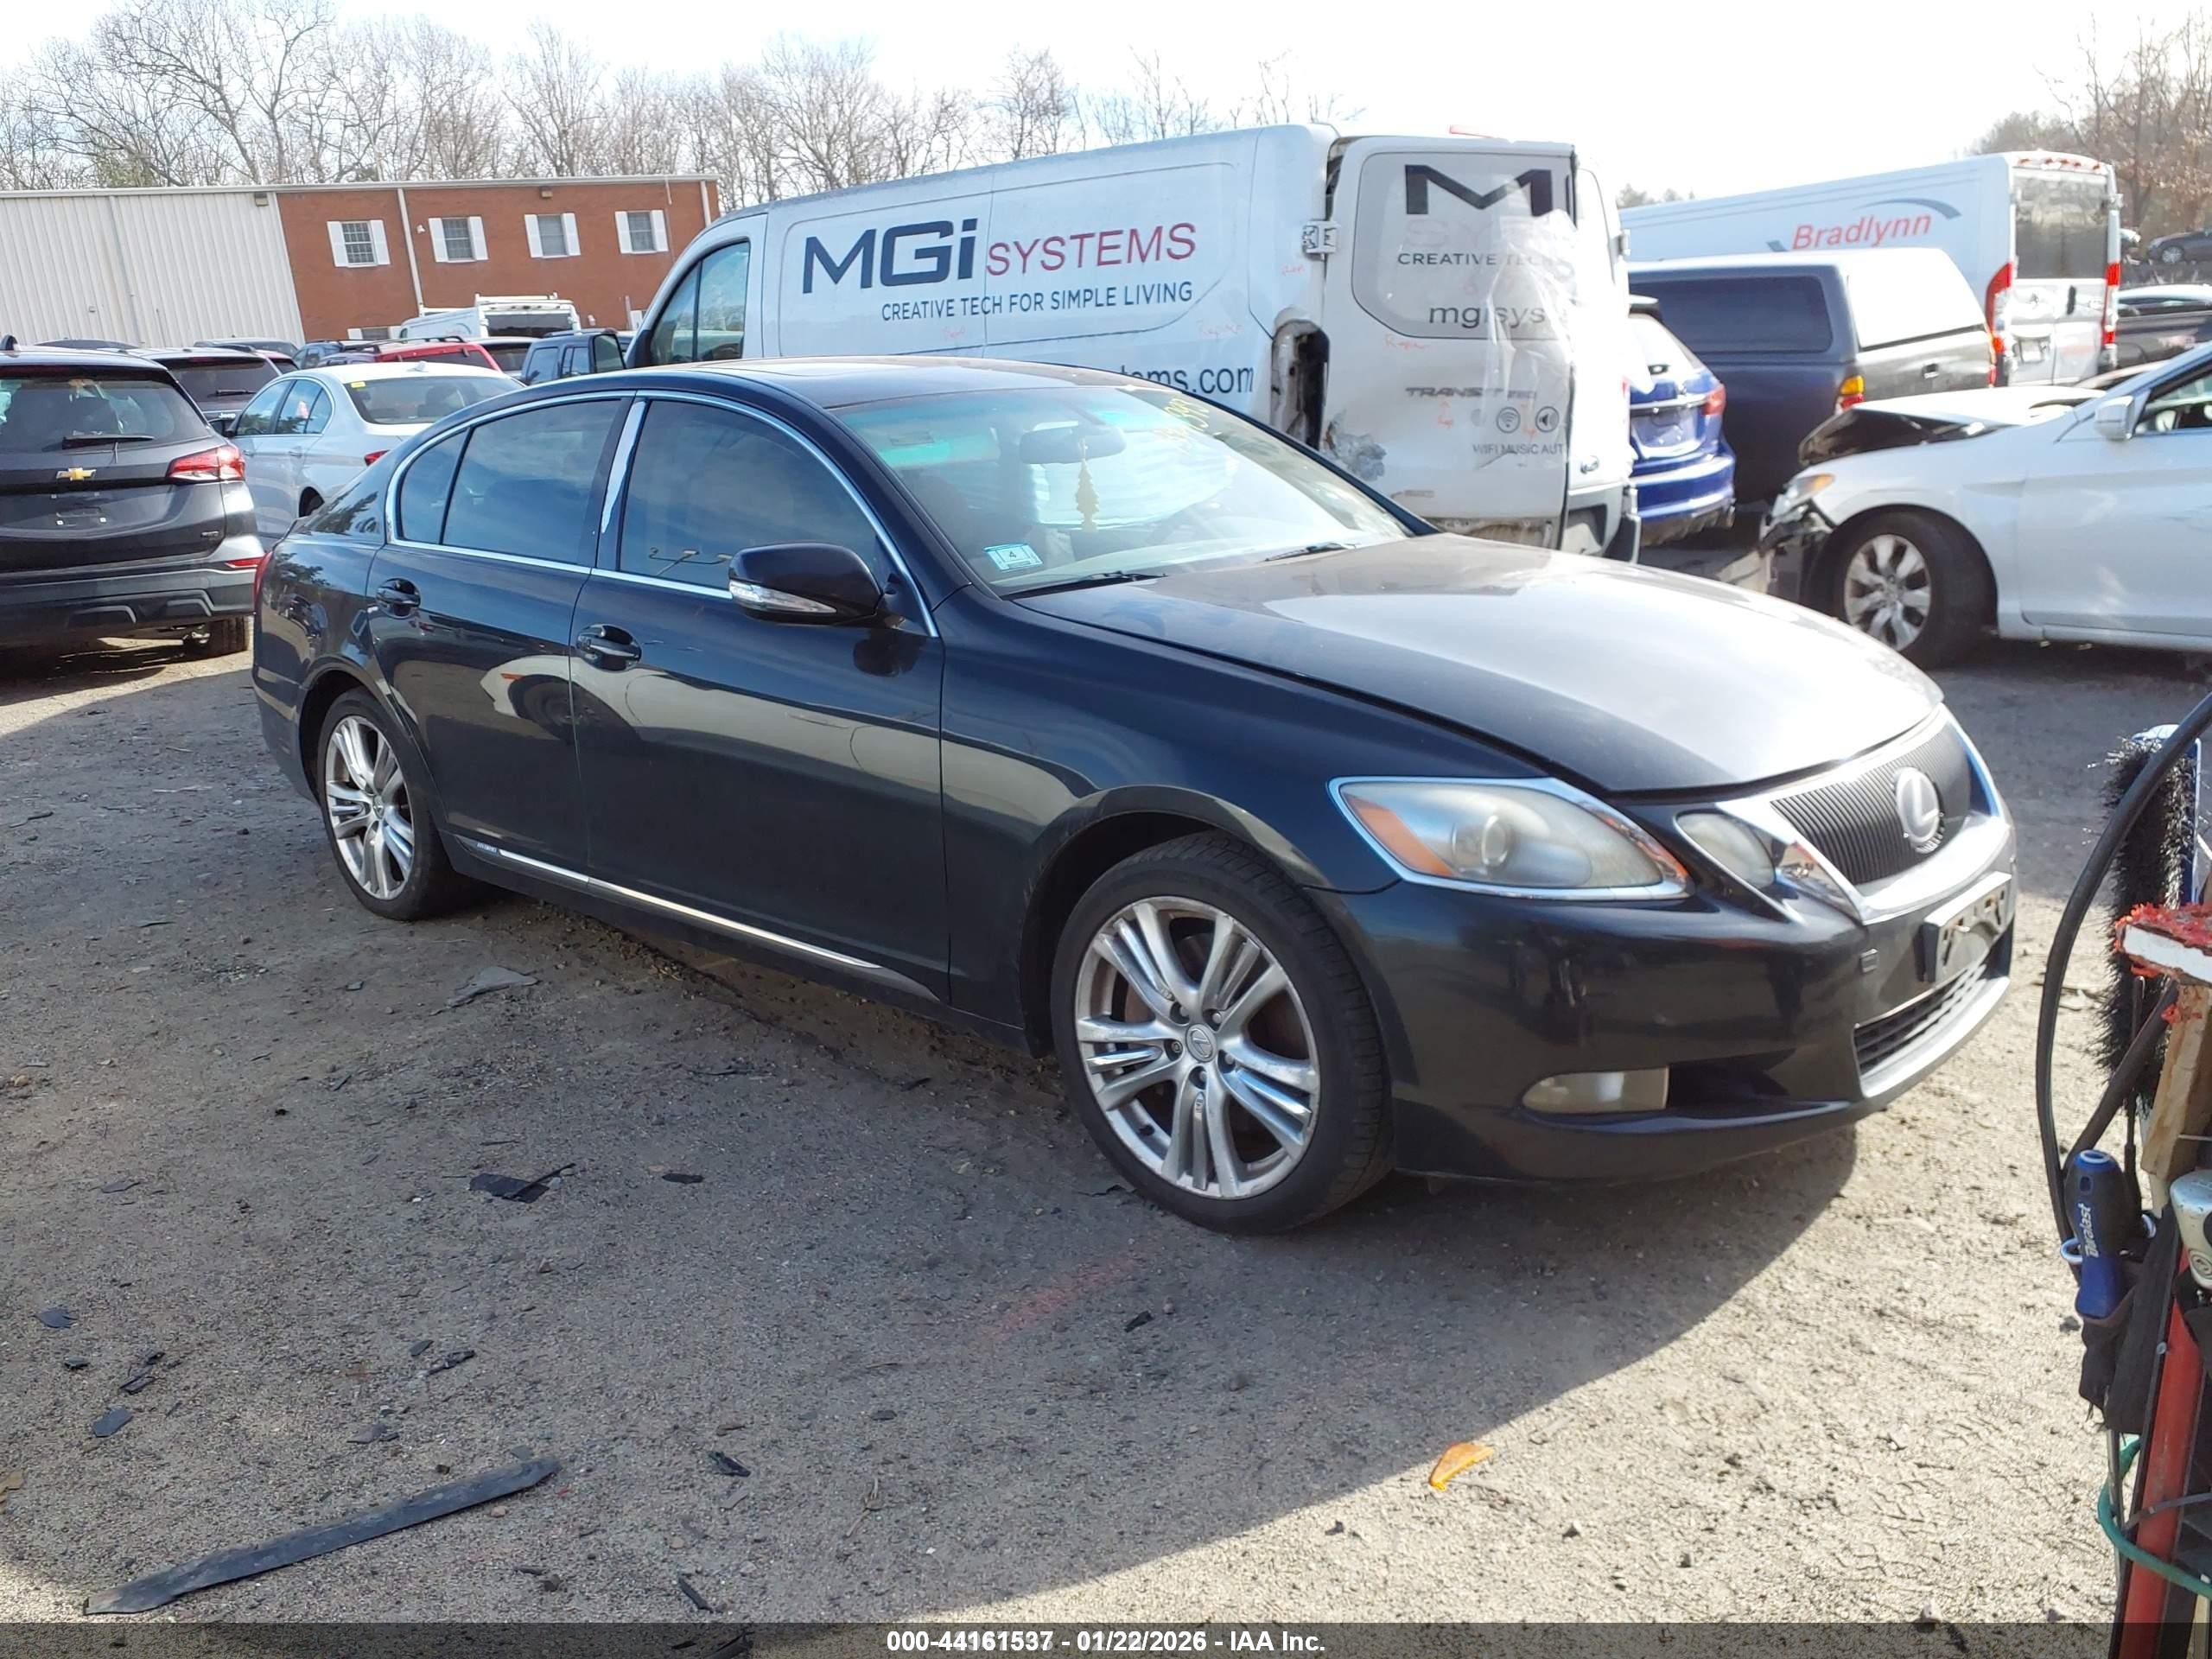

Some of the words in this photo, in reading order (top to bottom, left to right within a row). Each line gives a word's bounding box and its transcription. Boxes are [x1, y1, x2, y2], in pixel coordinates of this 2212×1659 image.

[1792, 214, 1932, 250] Bradlynn
[802, 218, 978, 294] MGi
[986, 222, 1197, 276] SYSTEMS
[1397, 252, 1497, 266] CREATIVE
[881, 297, 955, 321] CREATIVE
[960, 294, 1003, 315] TECH
[1009, 291, 1045, 312] FOR
[1051, 286, 1116, 309] SIMPLE
[1123, 281, 1192, 305] LIVING
[1405, 387, 1504, 397] TRANST
[1472, 443, 1498, 454] WIFI
[1501, 443, 1539, 454] MUSIC
[2078, 1203, 2100, 1258] Duralast
